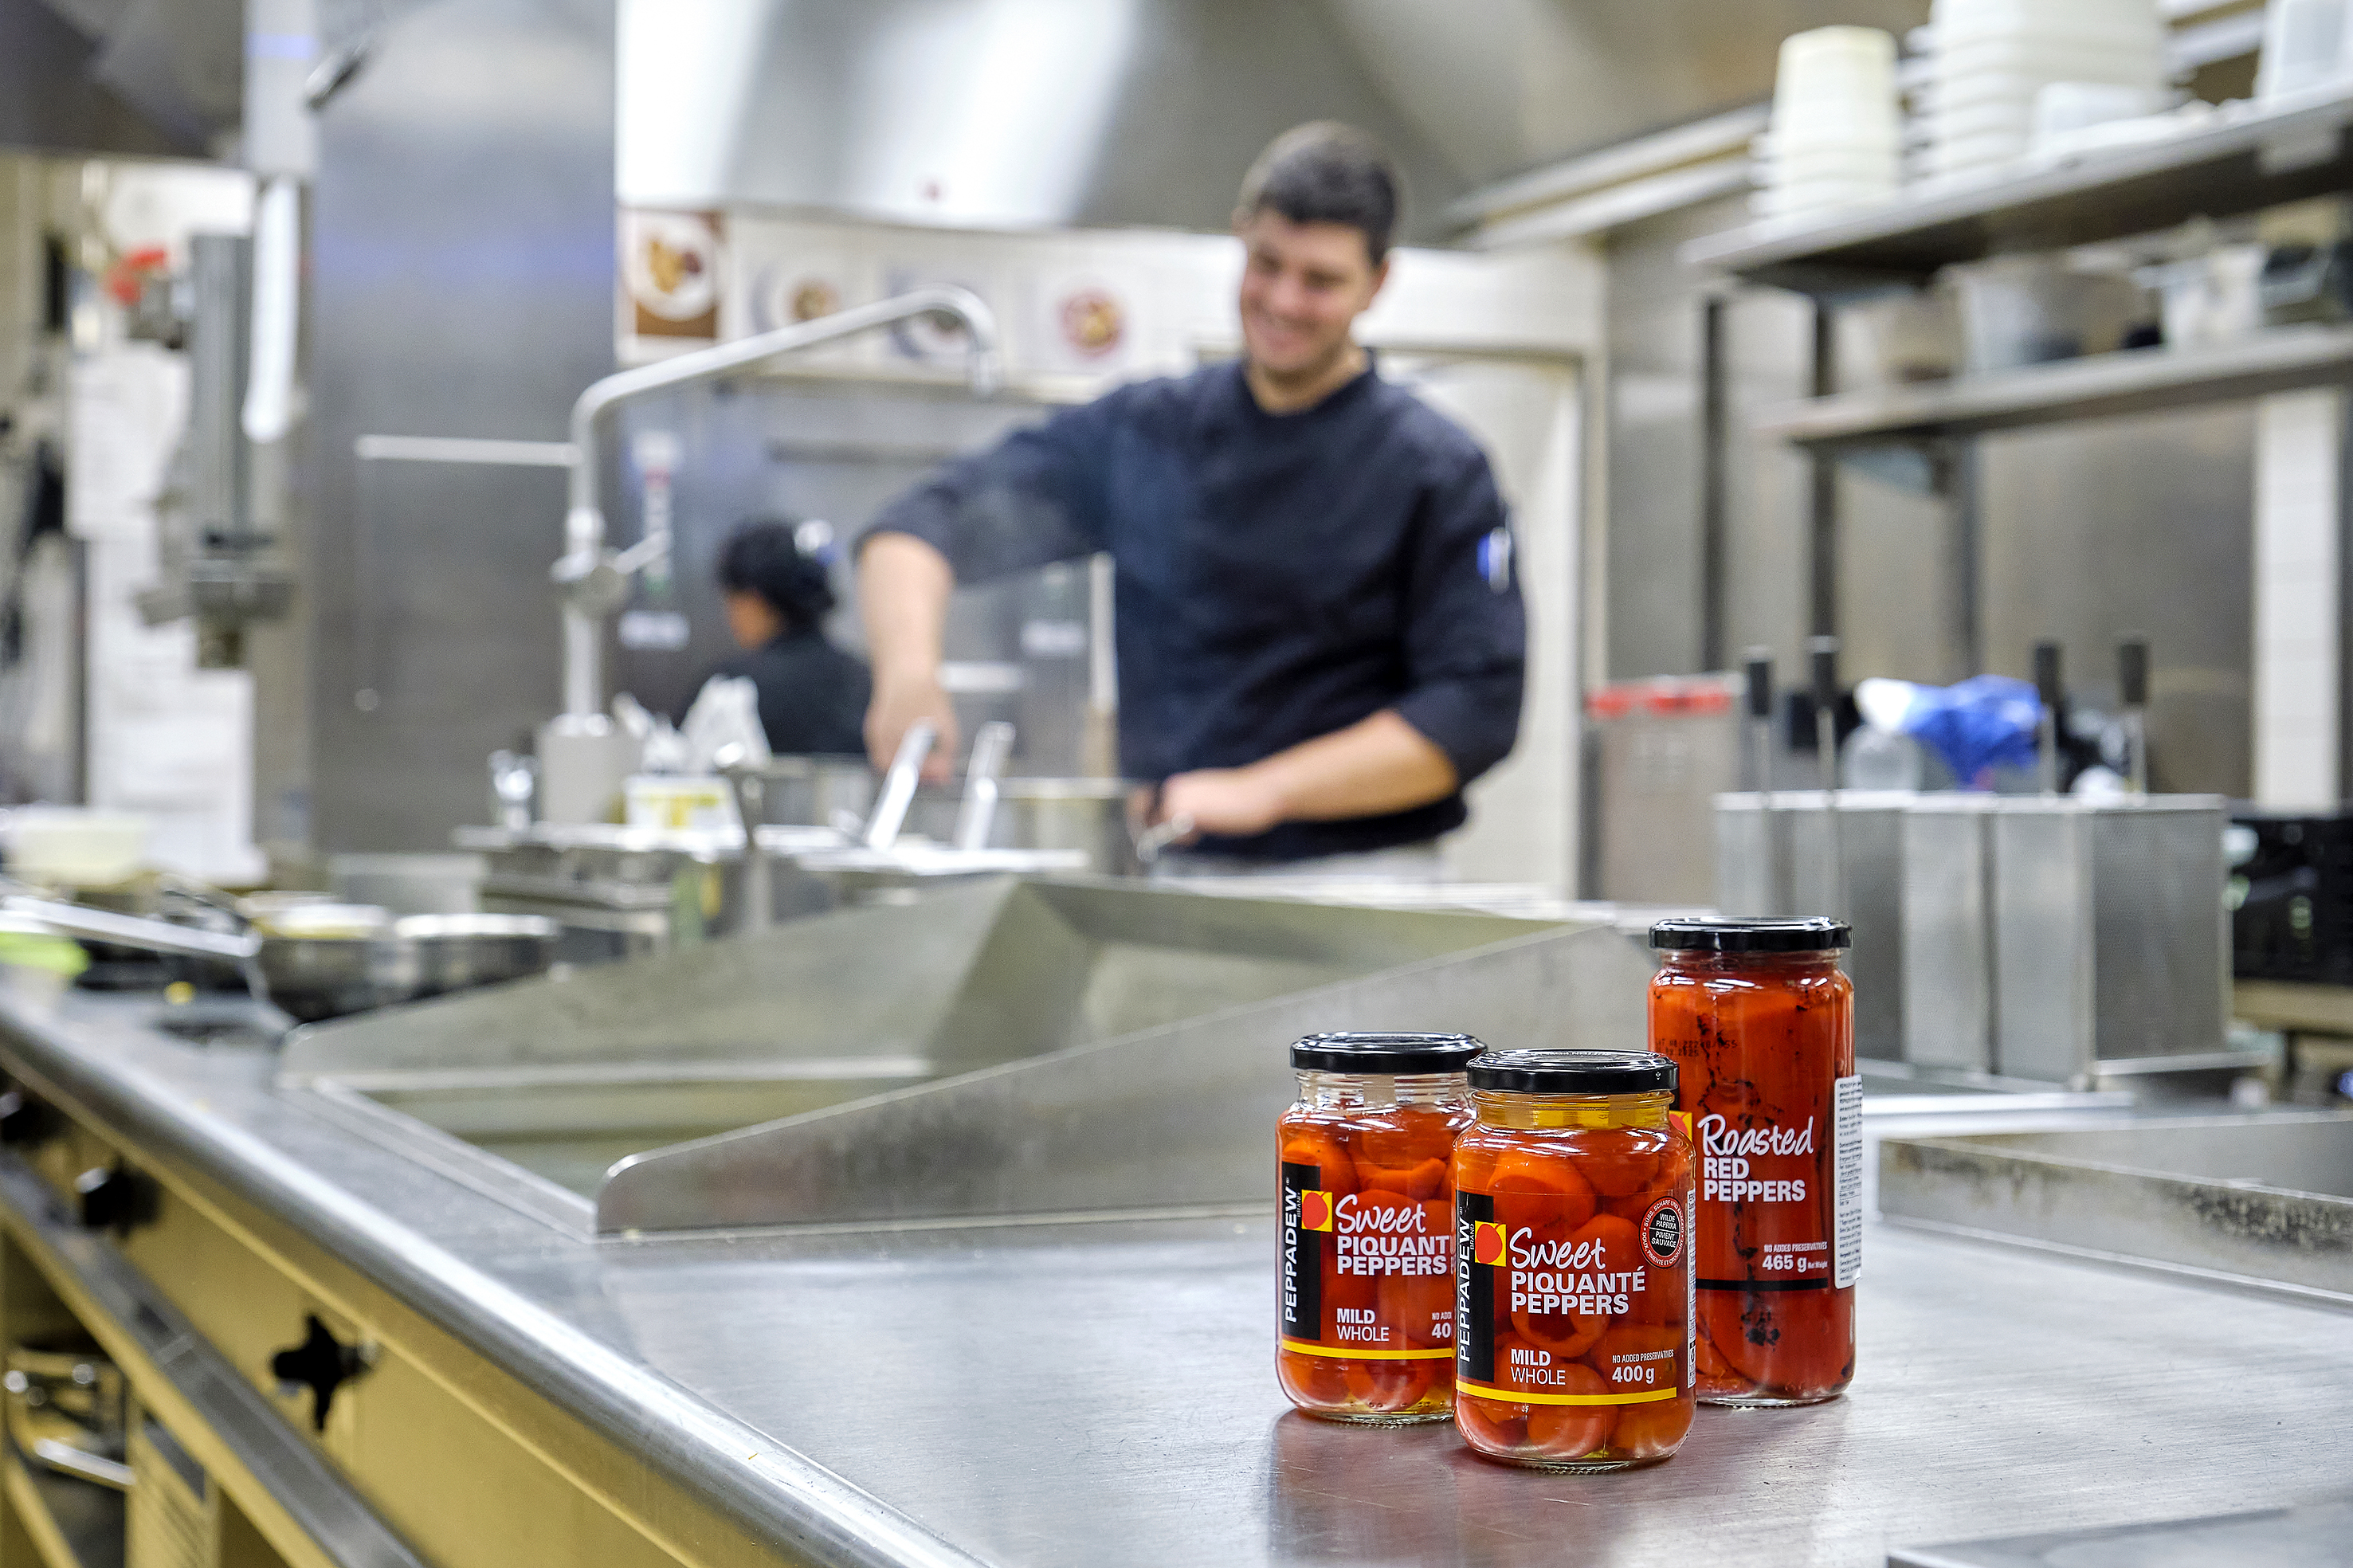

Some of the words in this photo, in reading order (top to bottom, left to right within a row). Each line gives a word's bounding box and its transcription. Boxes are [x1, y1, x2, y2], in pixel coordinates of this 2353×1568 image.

[1697, 1113, 1814, 1156] Roasted
[1704, 1157, 1750, 1179] RED
[1704, 1179, 1806, 1202] PEPPERS
[1335, 1194, 1426, 1233] Sweet
[1660, 1213, 1676, 1222] WILDE
[1656, 1220, 1677, 1230] PAPRIKA
[1337, 1236, 1450, 1256] PIQUANT
[1651, 1237, 1677, 1249] SAUVAGE
[1656, 1231, 1675, 1241] PIMENT
[1285, 1186, 1297, 1323] PEPPADEW
[1509, 1226, 1606, 1270] Sweet
[1763, 1244, 1773, 1252] NO
[1773, 1243, 1791, 1252] ADDED
[1792, 1241, 1828, 1252] PRESERVATIVES
[1337, 1255, 1447, 1276] PEPPERS
[1762, 1254, 1794, 1271] 465
[1797, 1257, 1807, 1273] g
[1459, 1217, 1470, 1362] PEPPADEW
[1511, 1265, 1646, 1294] PIQUANTÉ
[1511, 1292, 1629, 1315] PEPPERS
[1336, 1307, 1375, 1324] MILD
[1336, 1325, 1390, 1342] WHOLE
[1432, 1323, 1452, 1339] 40
[1511, 1349, 1551, 1366] MILD
[1612, 1354, 1621, 1363] NO
[1622, 1353, 1640, 1363] ADDED
[1641, 1349, 1674, 1362] PRESERVATIVES
[1511, 1366, 1566, 1386] WHOLE
[1612, 1365, 1643, 1383] 400
[1645, 1367, 1655, 1385] g
